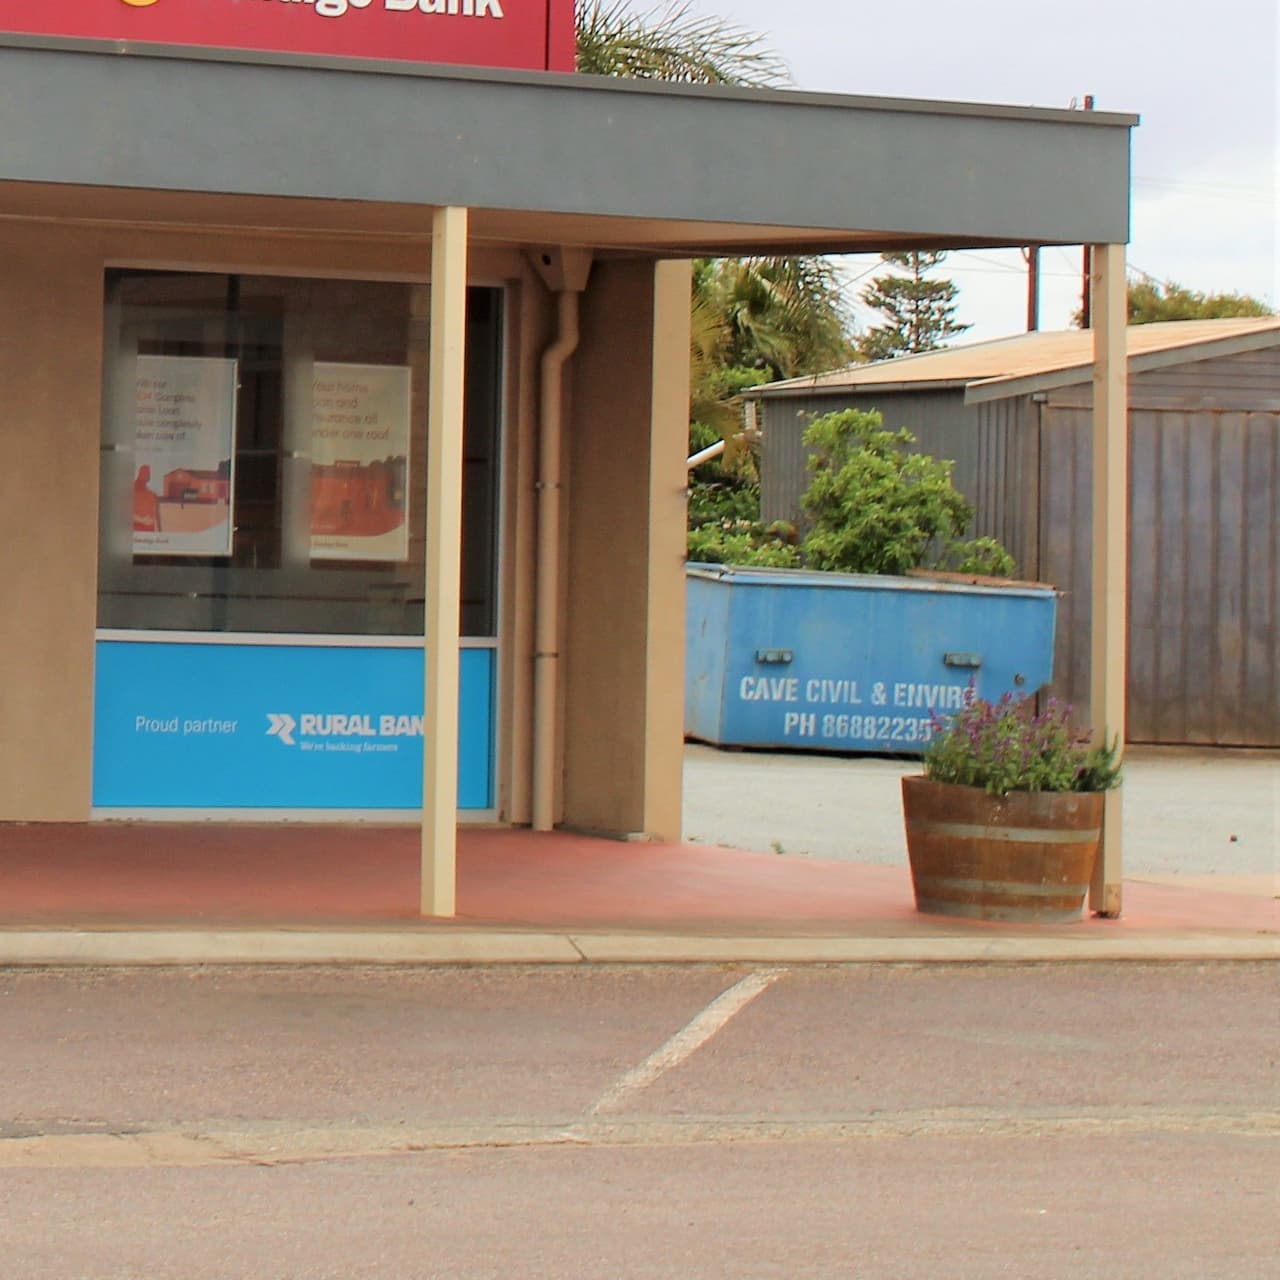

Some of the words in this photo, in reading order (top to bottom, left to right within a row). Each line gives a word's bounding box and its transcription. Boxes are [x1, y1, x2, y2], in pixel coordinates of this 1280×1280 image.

[740, 675, 798, 703] CAVE
[806, 678, 863, 705] CIVIL
[871, 681, 888, 706] &
[135, 715, 179, 734] Proud
[183, 716, 238, 737] partner
[299, 713, 377, 737] RURAL
[379, 714, 426, 738] BAN
[784, 712, 814, 737] PH
[821, 713, 934, 742] 86882235
